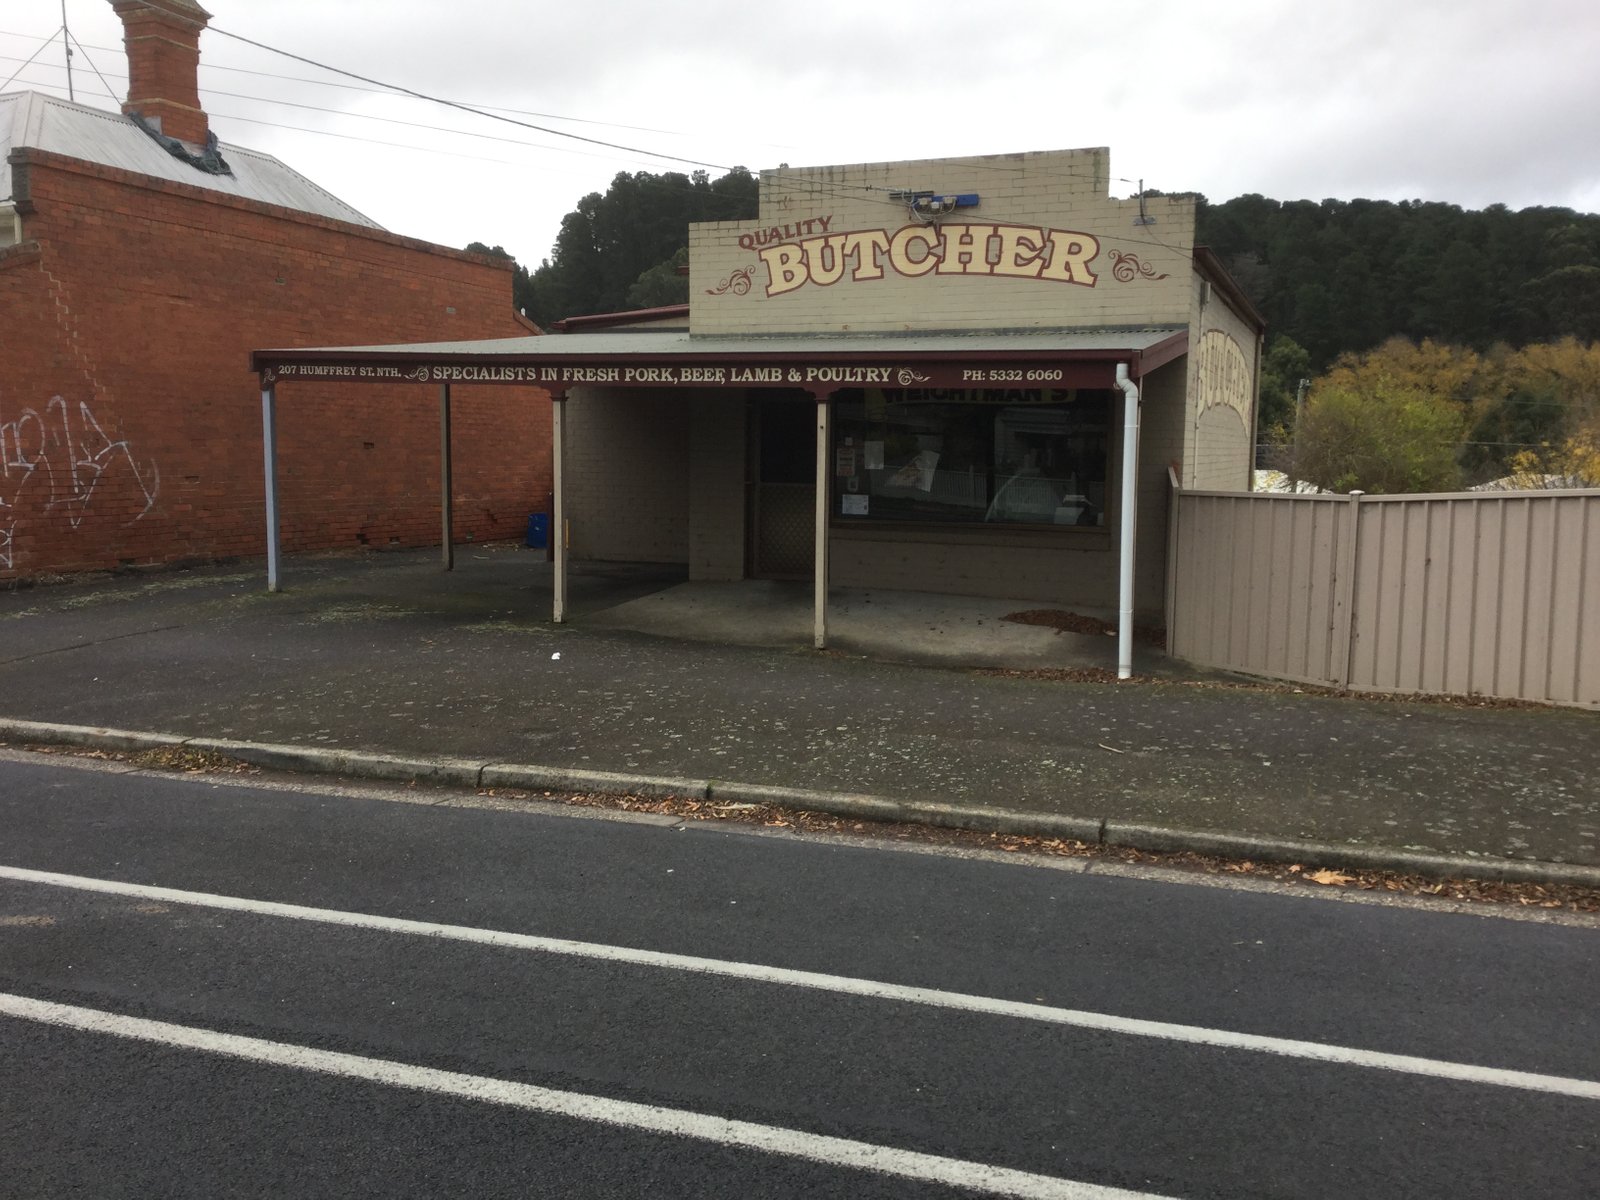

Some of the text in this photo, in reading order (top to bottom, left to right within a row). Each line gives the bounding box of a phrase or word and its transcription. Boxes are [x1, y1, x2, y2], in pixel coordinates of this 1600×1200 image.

[738, 215, 833, 251] QUALITY
[758, 222, 1100, 298] BUTCHER
[278, 364, 402, 378] 207 HUMFFREY ST. NTH.
[432, 366, 893, 384] SPECIALISTS IN FRESH PORK, BEEF, LAMB & POULTRY
[962, 369, 1063, 381] PH: 5332 6060
[881, 388, 1070, 402] WEIGHTMANS
